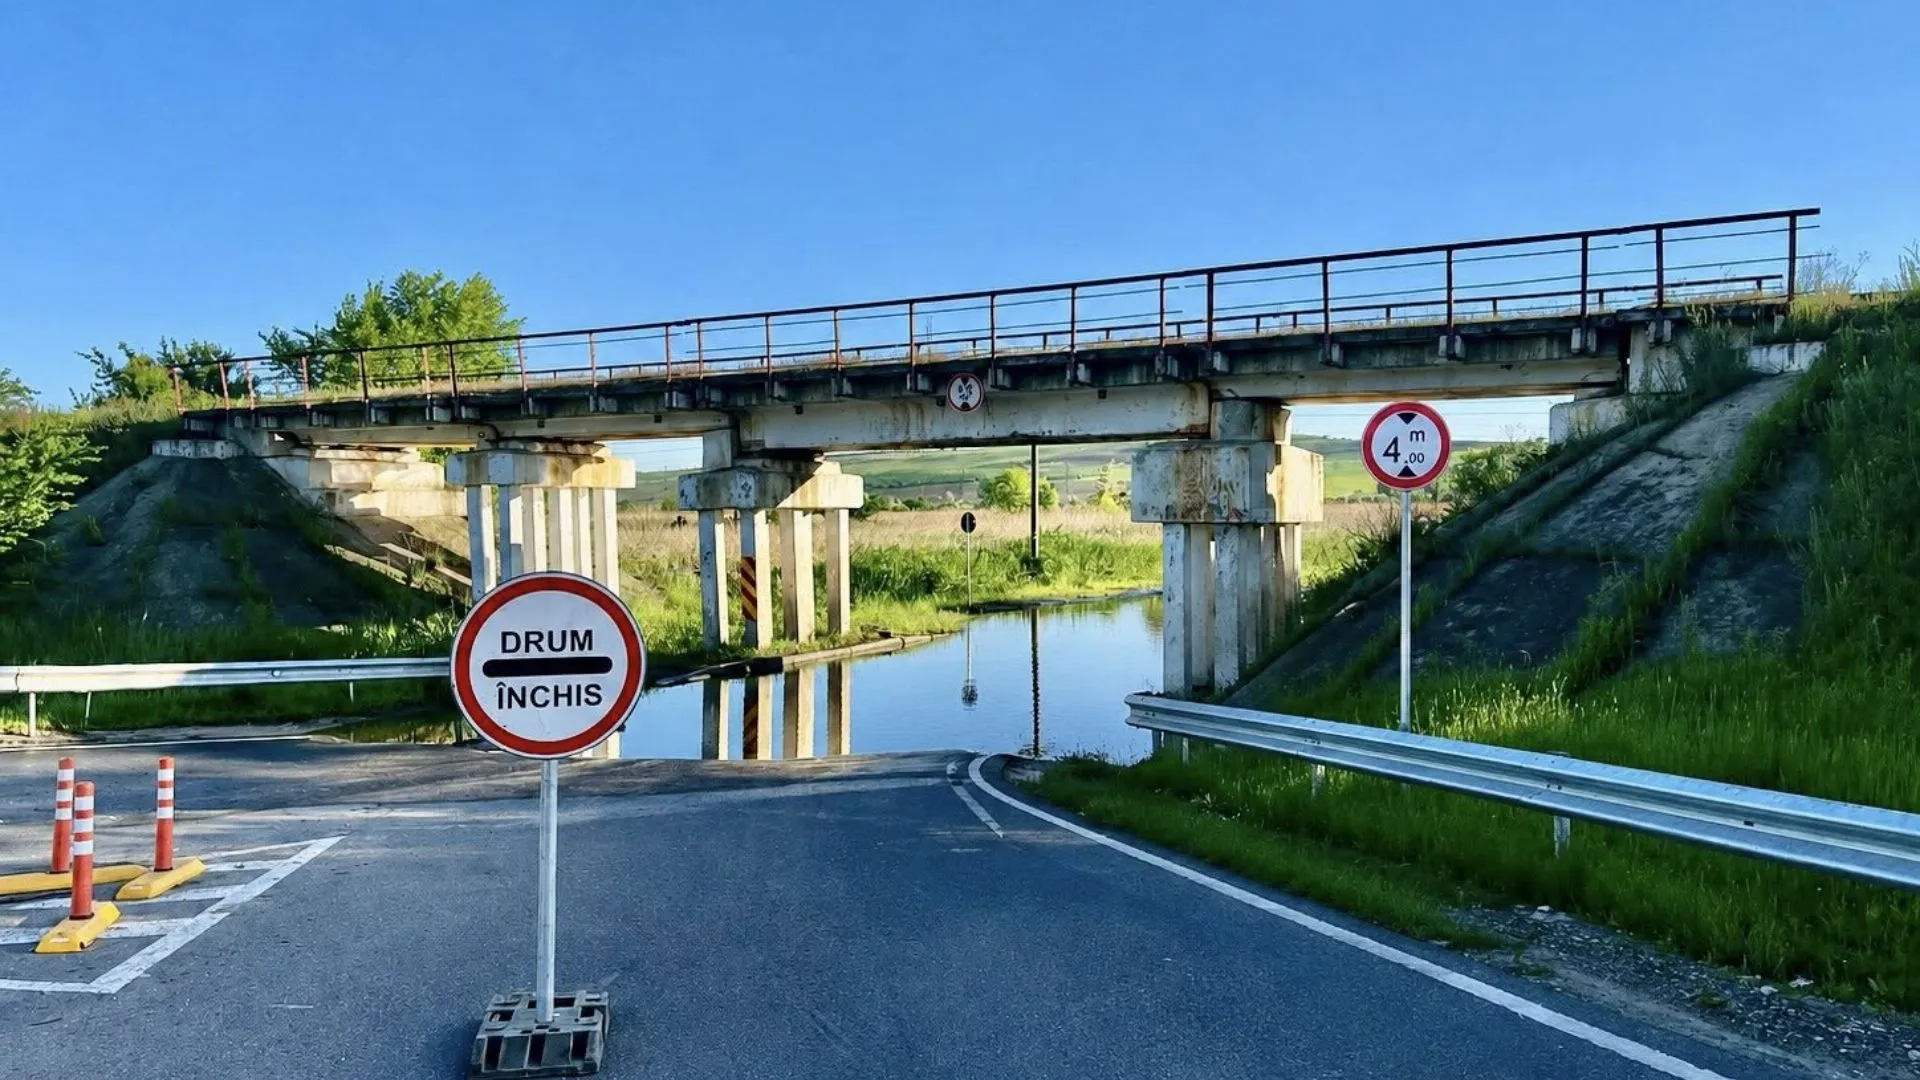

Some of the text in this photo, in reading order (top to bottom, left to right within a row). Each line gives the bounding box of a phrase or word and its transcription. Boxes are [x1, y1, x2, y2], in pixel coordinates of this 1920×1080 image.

[1410, 430, 1425, 442] m
[500, 629, 593, 653] DRUM
[496, 681, 603, 710] ÎNCHIS
